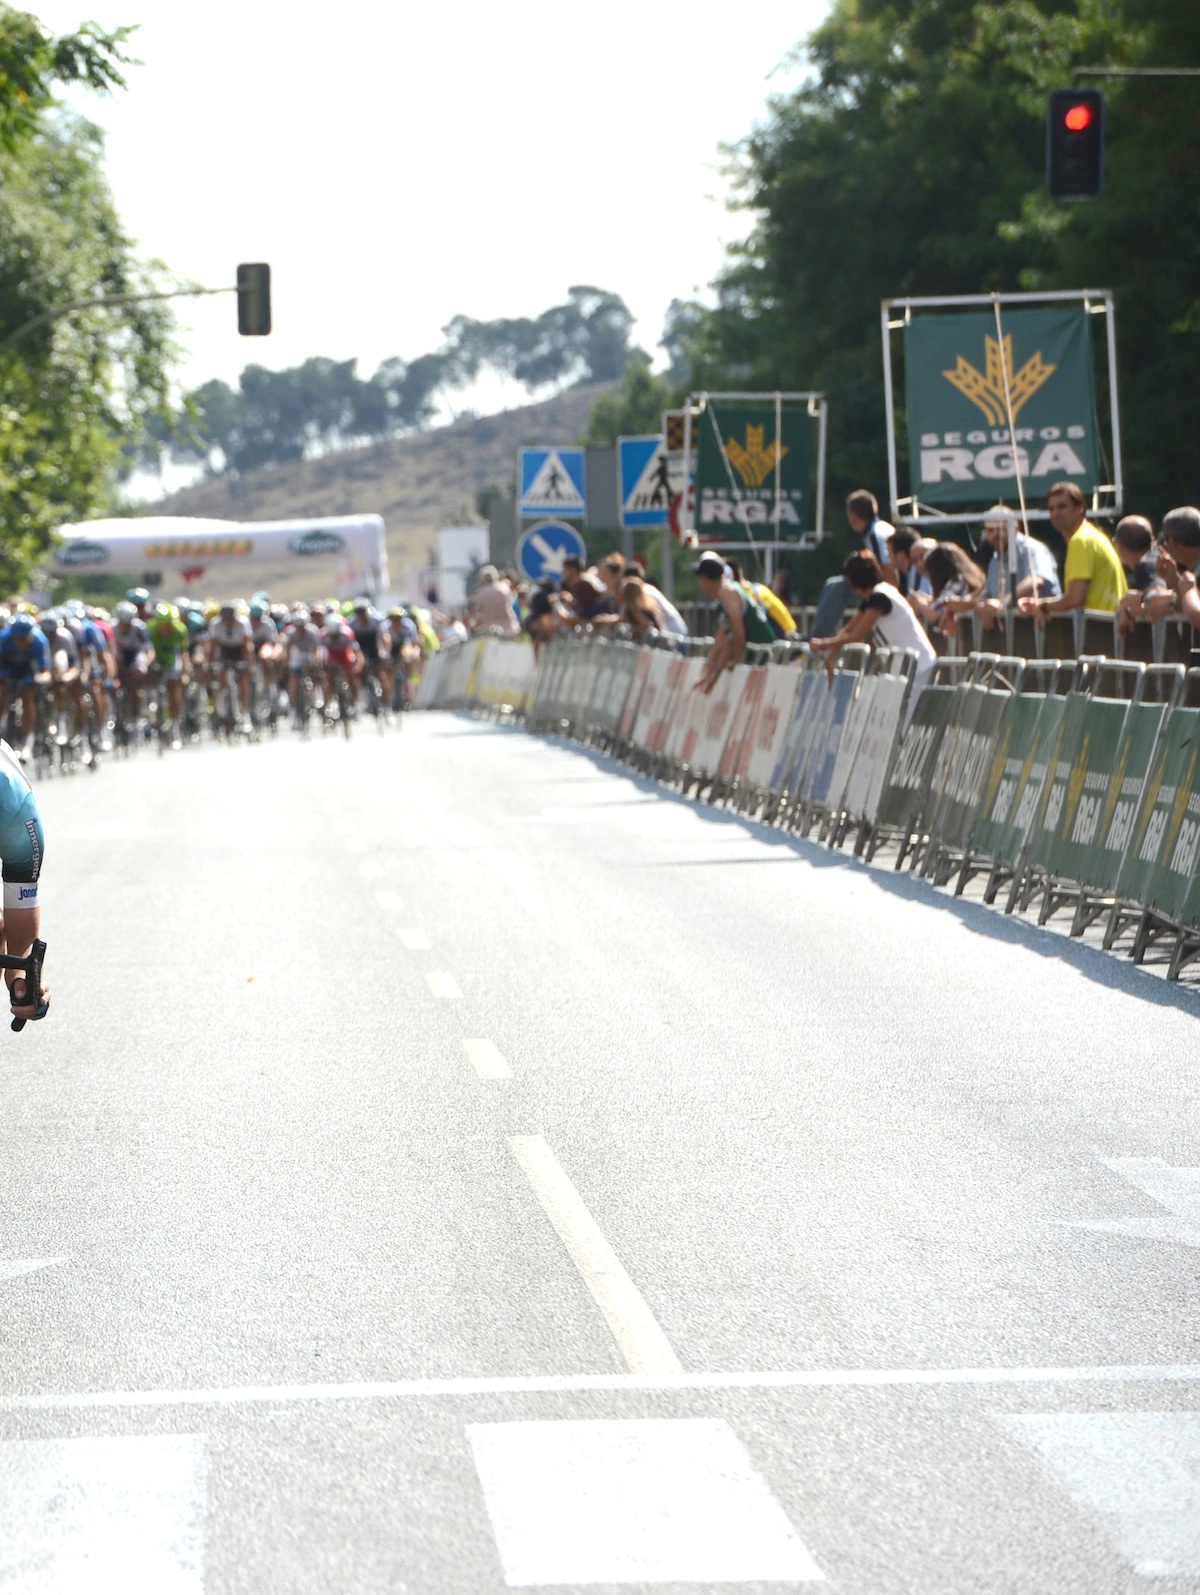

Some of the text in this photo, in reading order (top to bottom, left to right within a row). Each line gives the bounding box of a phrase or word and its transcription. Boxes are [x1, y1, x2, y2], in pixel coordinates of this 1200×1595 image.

[921, 425, 1086, 447] SEGUROS
[920, 442, 1086, 483] RGA
[701, 501, 800, 525] RGA
[1071, 795, 1103, 845] RGA
[1105, 801, 1136, 851] RGA
[1139, 809, 1169, 862] RGA
